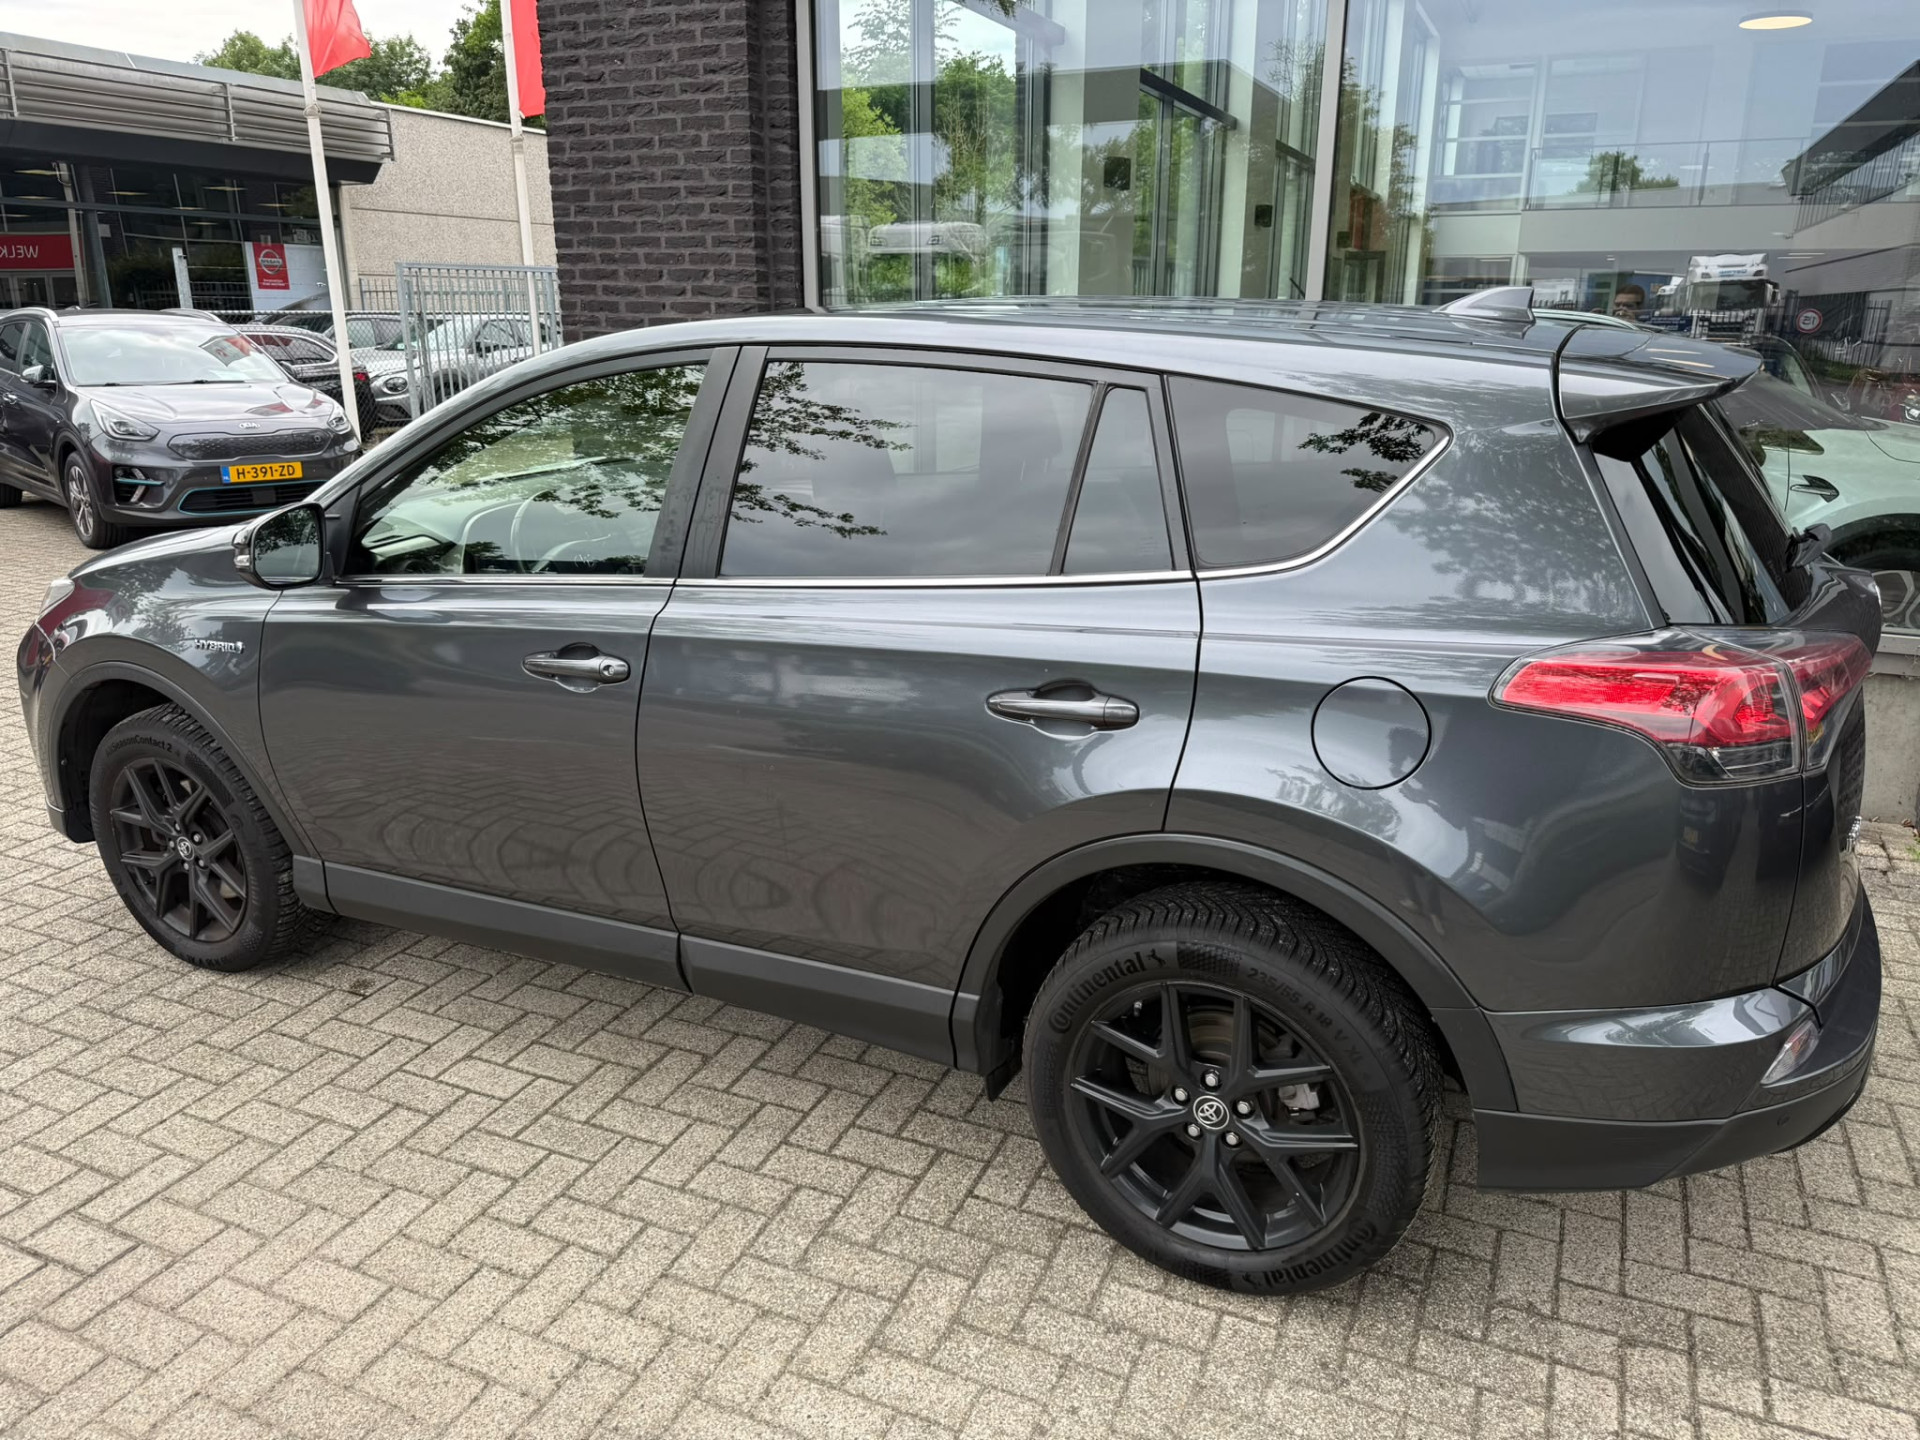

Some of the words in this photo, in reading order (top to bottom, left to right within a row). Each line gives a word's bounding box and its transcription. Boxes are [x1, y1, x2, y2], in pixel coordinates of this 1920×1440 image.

[236, 464, 296, 480] H-391-ZD
[194, 639, 236, 653] HYBRID
[1048, 951, 1148, 1034] Continental
[1247, 967, 1302, 1003] 235/55
[1301, 1000, 1315, 1015] R
[1315, 1011, 1333, 1029] 18
[1261, 1218, 1378, 1288] Continental
